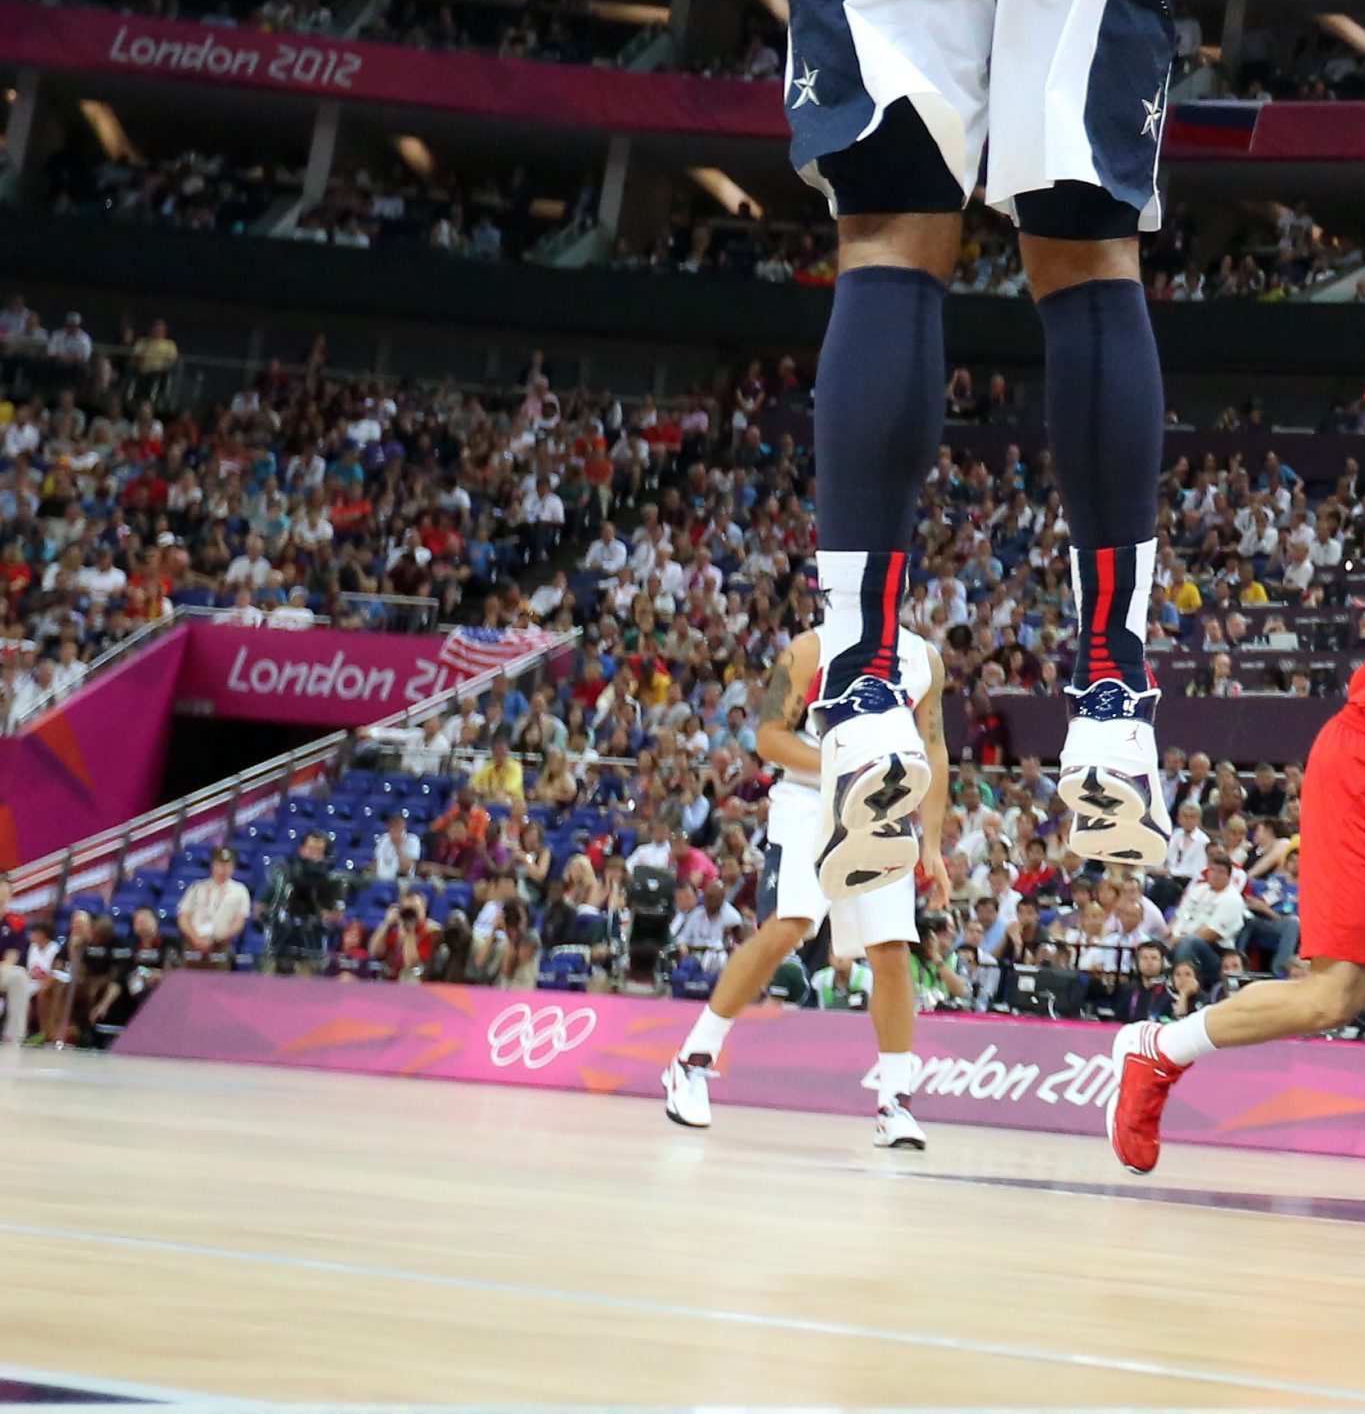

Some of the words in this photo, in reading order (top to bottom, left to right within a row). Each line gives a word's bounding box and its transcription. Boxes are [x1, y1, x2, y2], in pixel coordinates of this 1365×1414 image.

[109, 26, 260, 77] London
[267, 44, 363, 88] 2012
[227, 646, 396, 702] London
